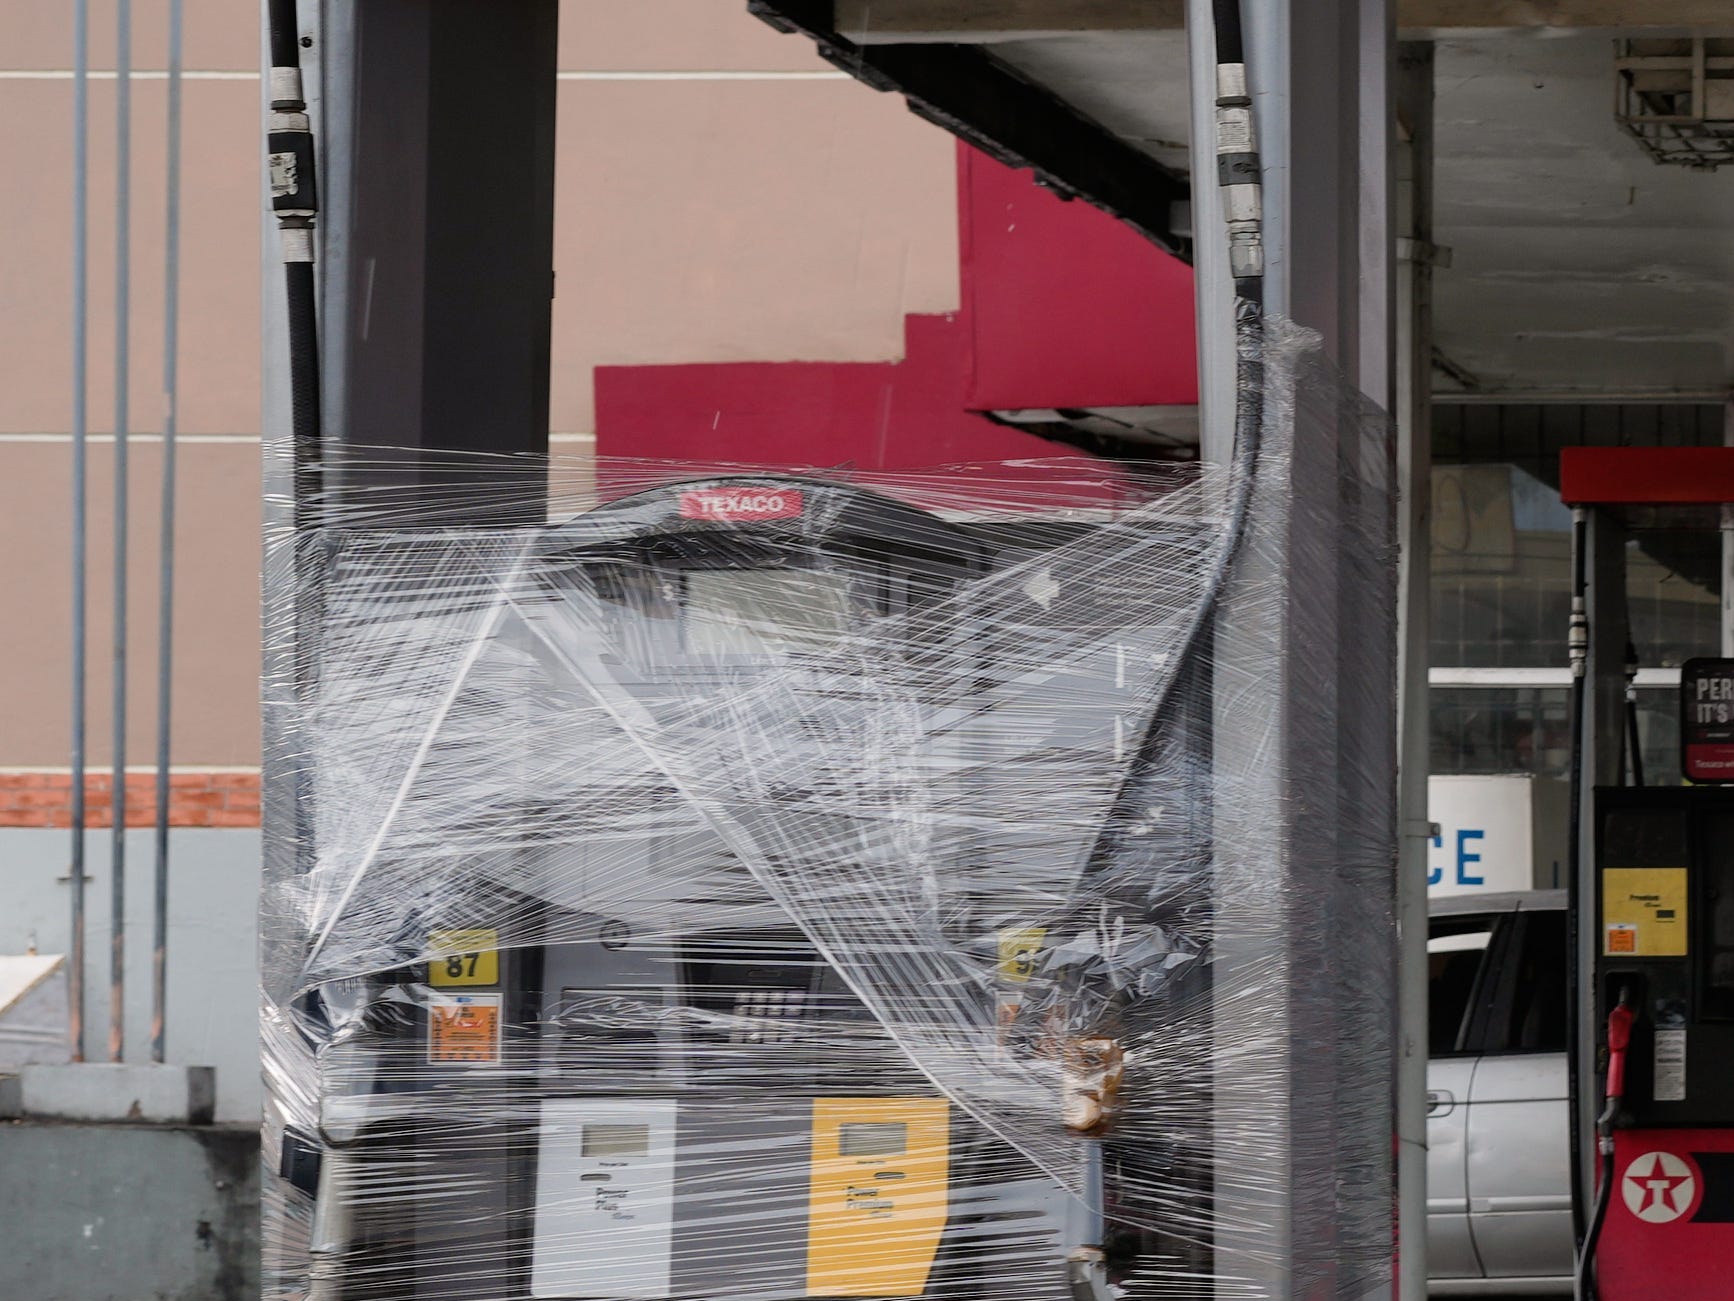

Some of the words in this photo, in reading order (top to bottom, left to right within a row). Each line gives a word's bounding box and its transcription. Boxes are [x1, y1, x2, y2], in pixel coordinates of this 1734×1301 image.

[697, 496, 785, 513] TEXACO
[1697, 703, 1728, 724] IT'S
[446, 950, 481, 978] 87
